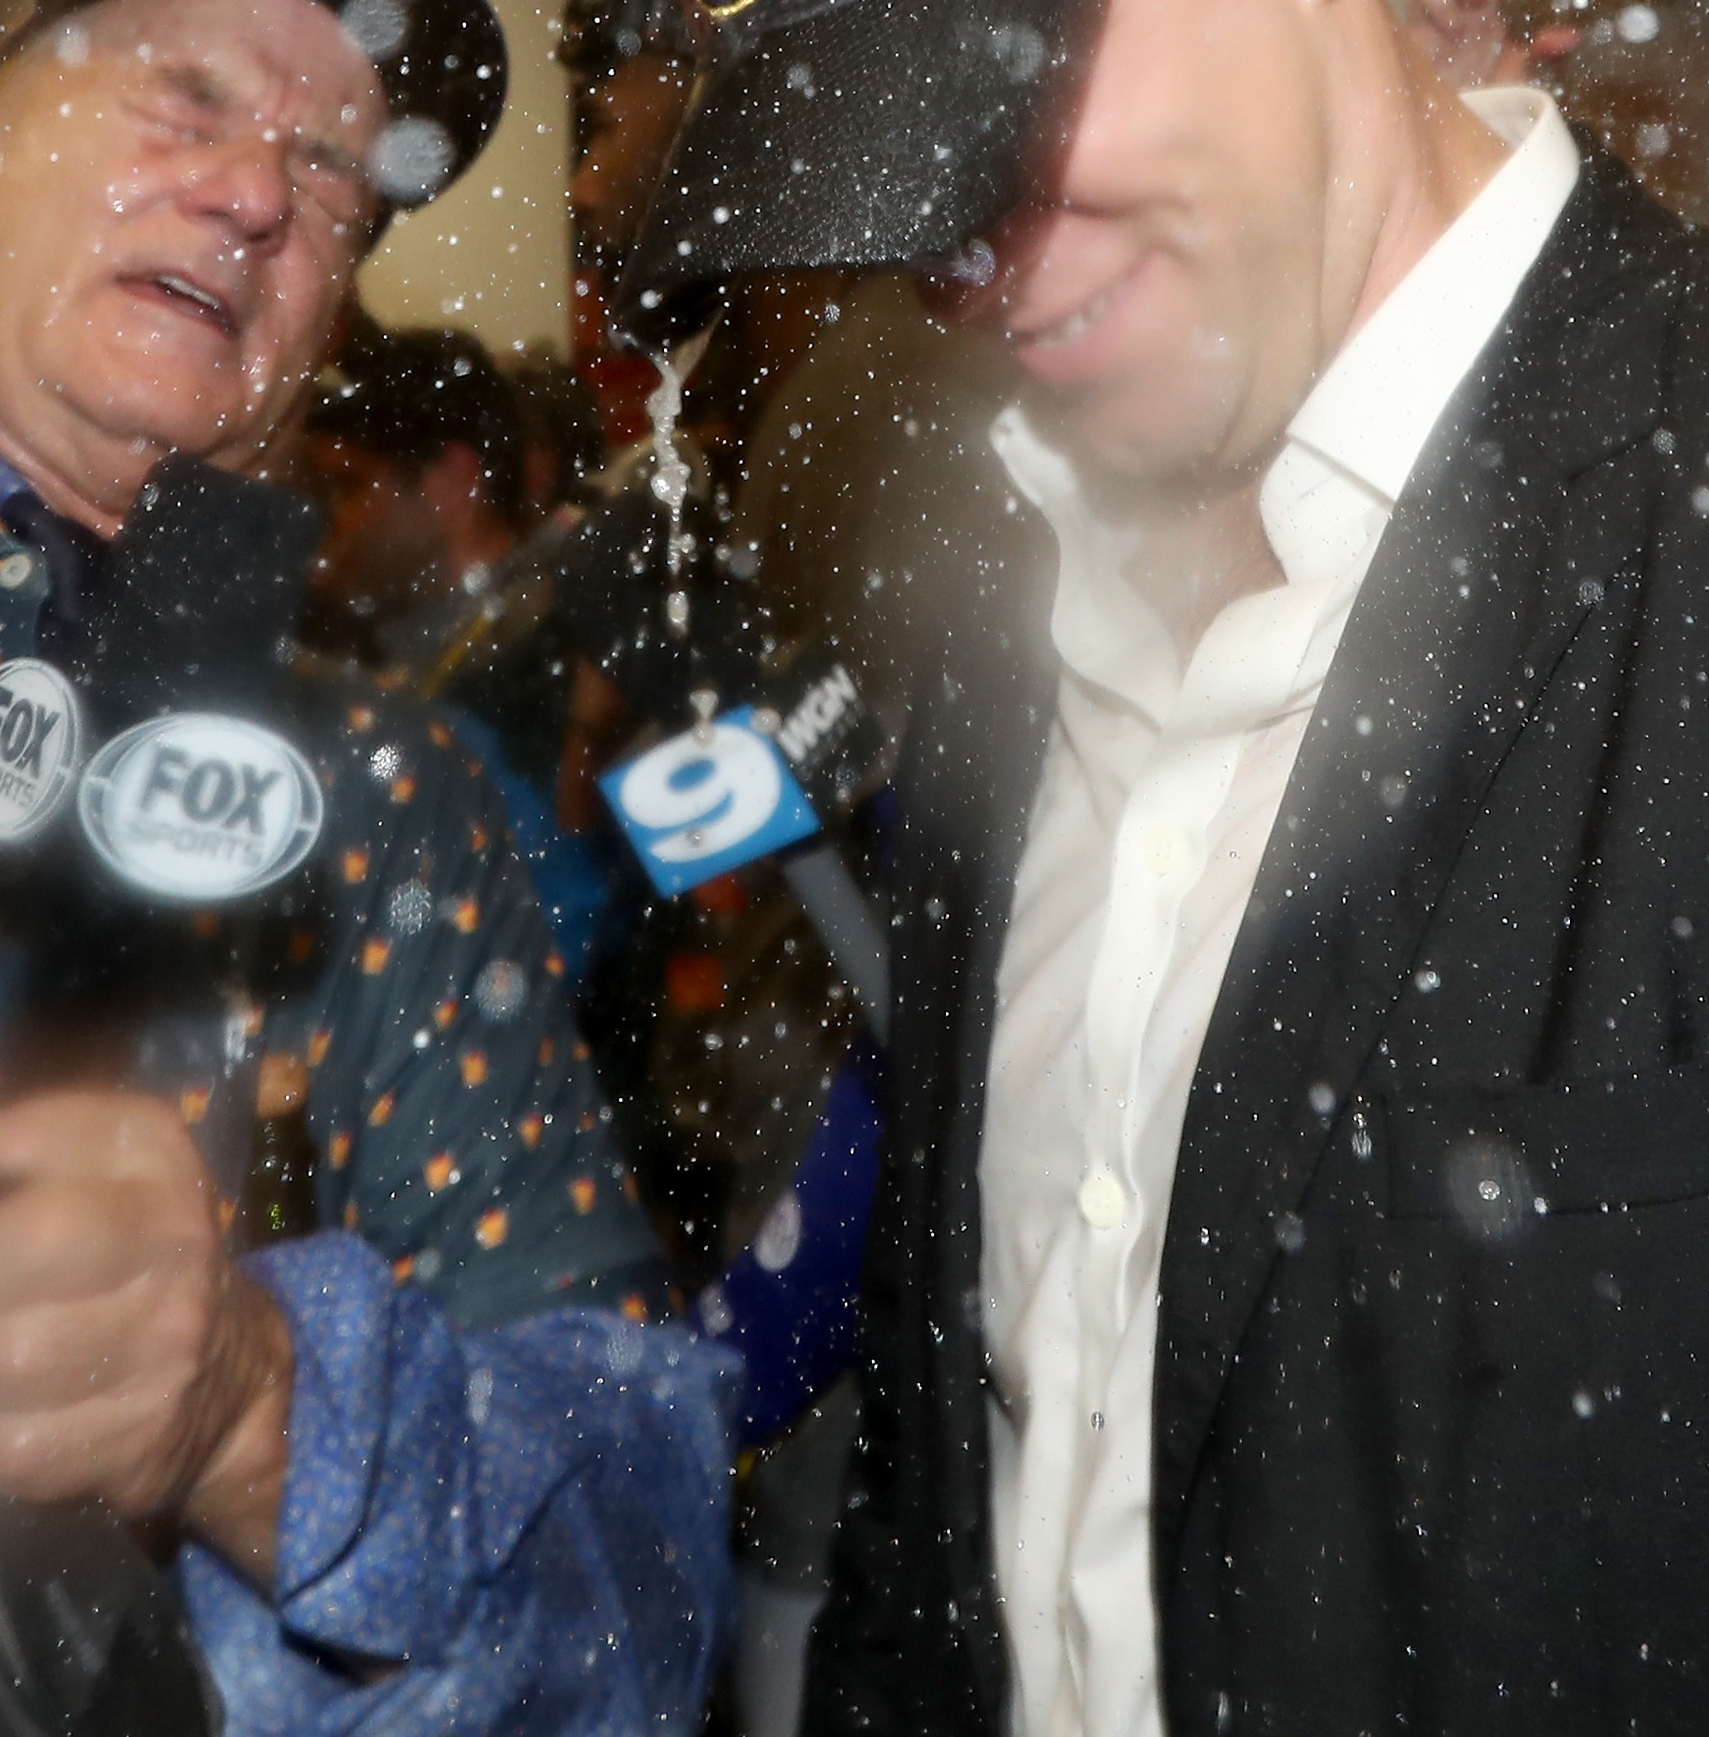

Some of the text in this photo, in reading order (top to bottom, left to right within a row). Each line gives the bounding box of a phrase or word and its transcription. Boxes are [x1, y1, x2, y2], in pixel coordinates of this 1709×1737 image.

[776, 664, 857, 761] WGN
[139, 742, 282, 837] FOX
[620, 723, 782, 863] 9
